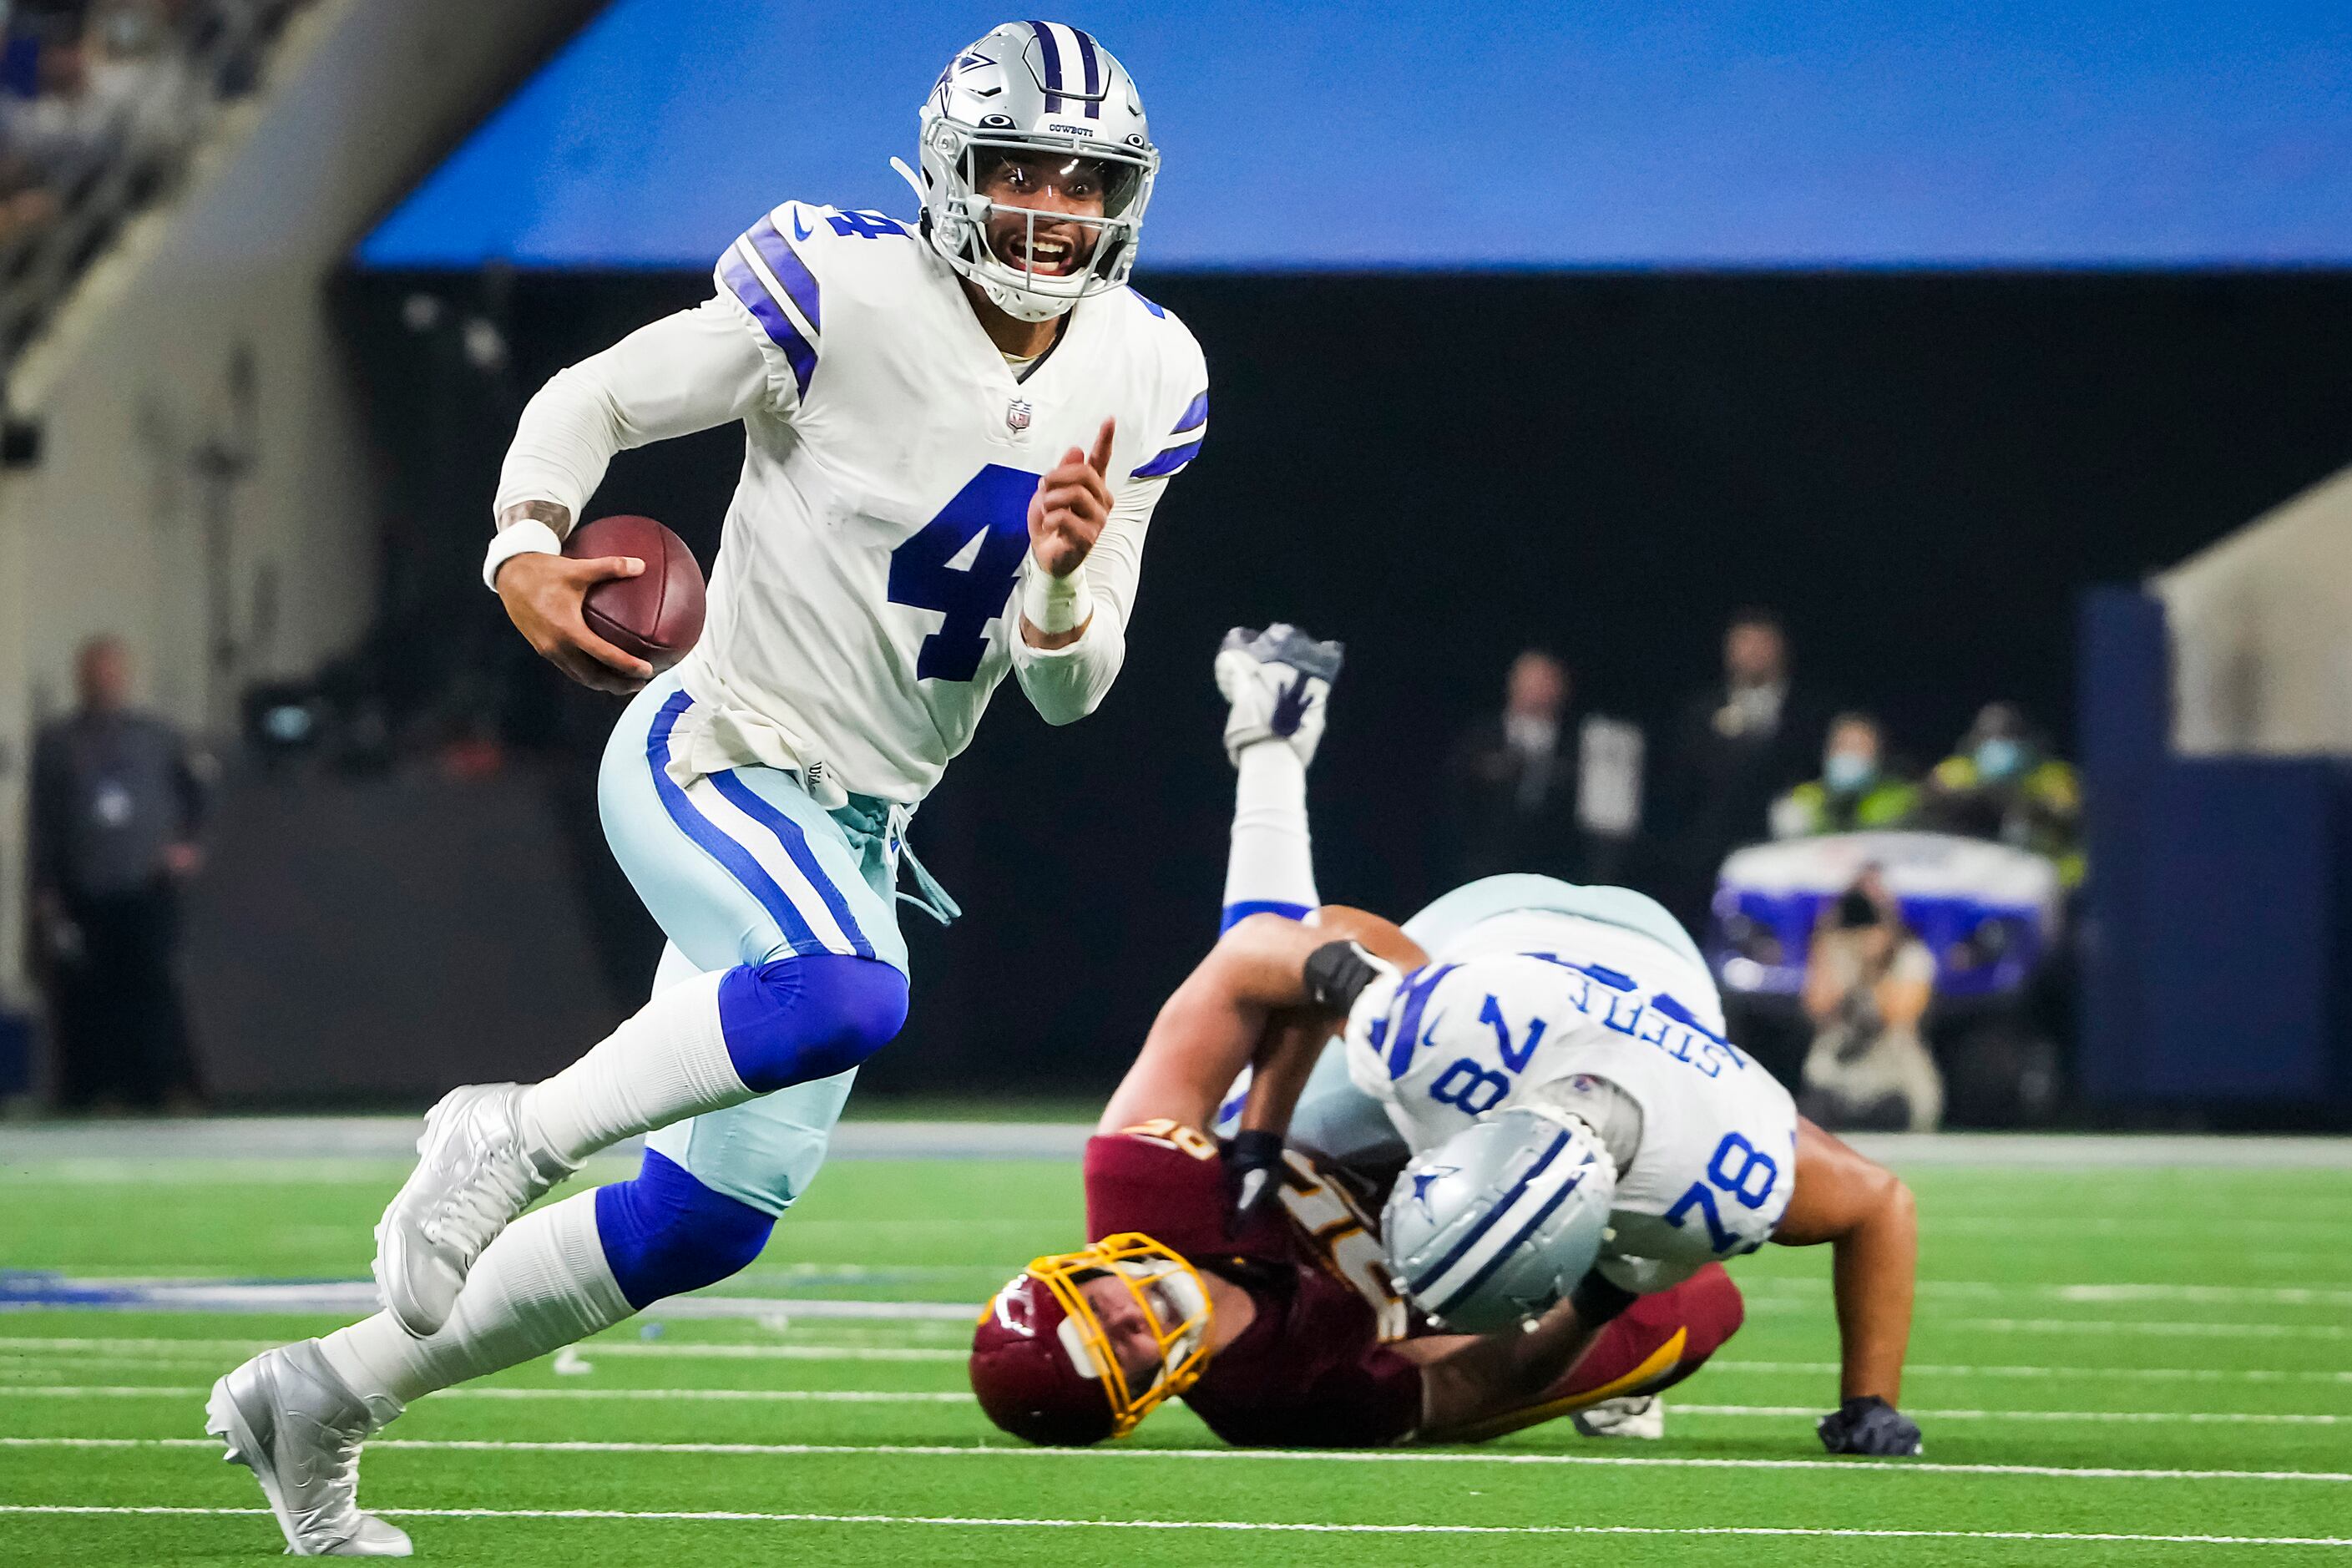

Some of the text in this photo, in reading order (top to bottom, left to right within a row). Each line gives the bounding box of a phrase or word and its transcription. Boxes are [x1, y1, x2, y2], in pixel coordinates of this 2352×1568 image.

[1049, 124, 1093, 138] COWBOYS
[825, 210, 914, 240] 4
[887, 463, 1043, 682] 4
[1429, 993, 1548, 1116] 78
[1663, 1130, 1778, 1254] 78
